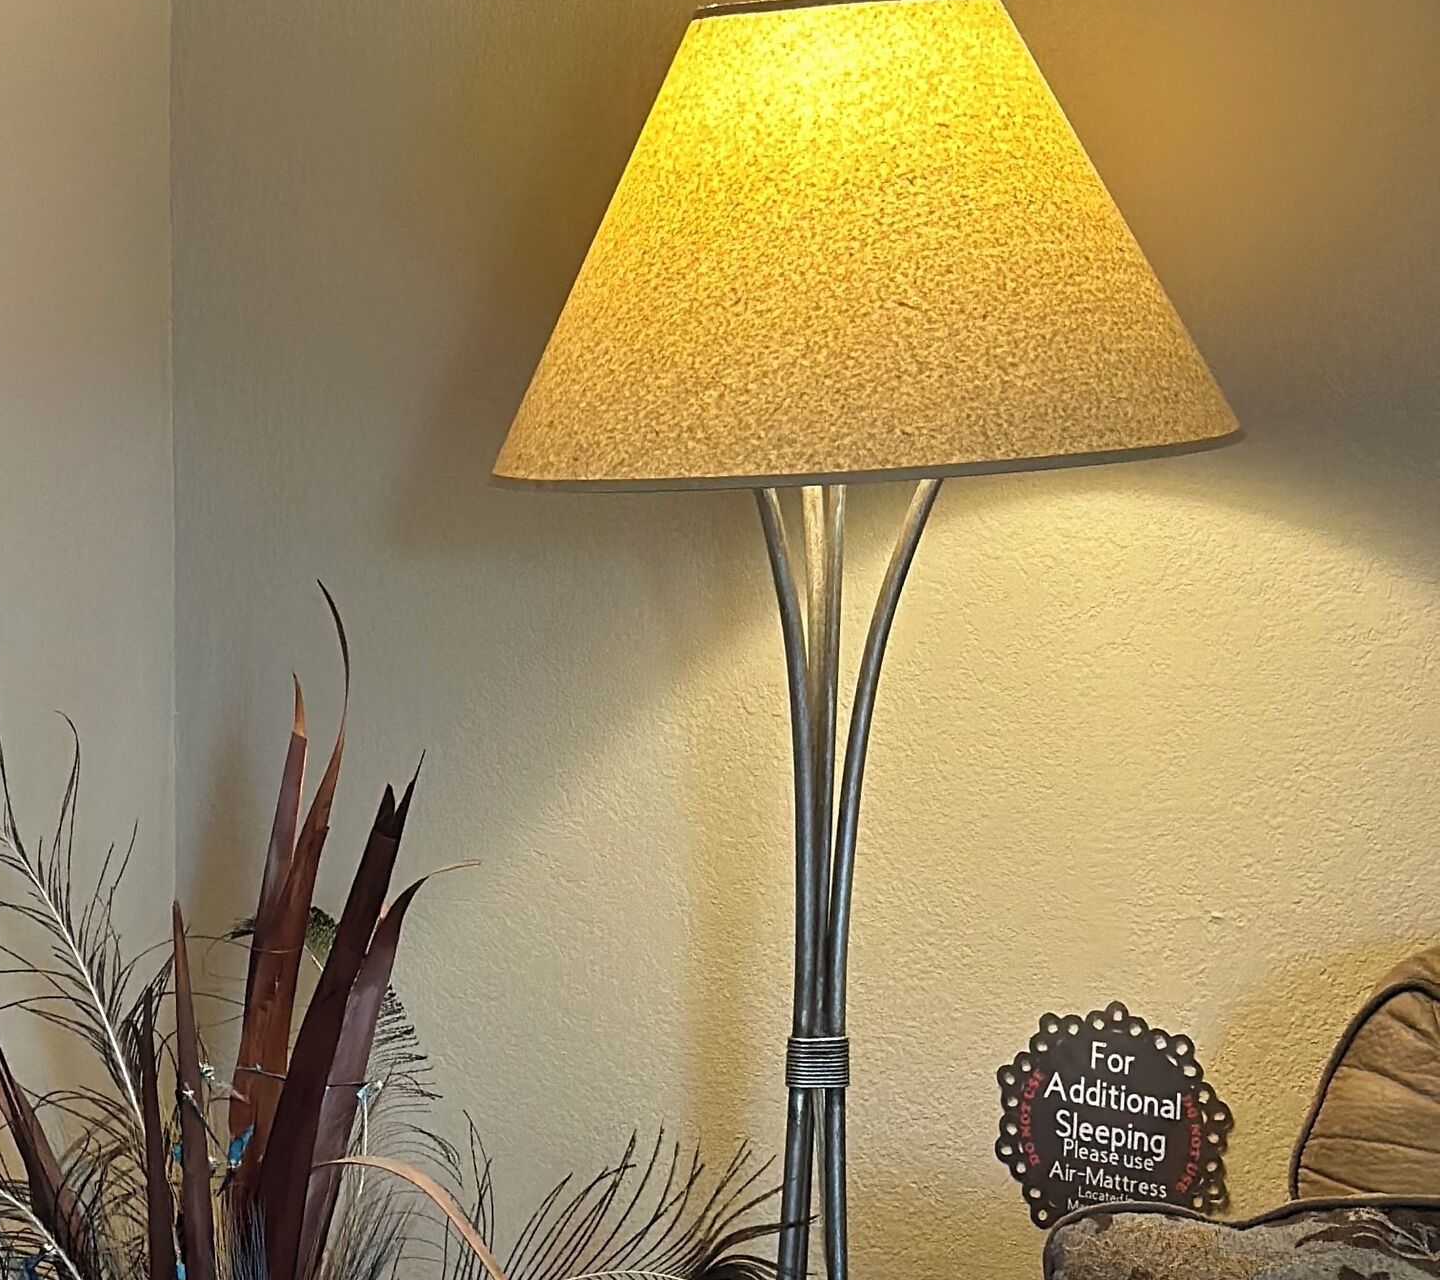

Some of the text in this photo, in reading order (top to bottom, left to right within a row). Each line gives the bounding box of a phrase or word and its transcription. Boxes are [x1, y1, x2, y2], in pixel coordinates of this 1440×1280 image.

[1090, 1041, 1135, 1075] For
[1023, 1067, 1044, 1099] USE
[1043, 1072, 1182, 1121] Additional
[1055, 1109, 1166, 1161] Sleeping
[1176, 1094, 1202, 1196] DO NOT USE
[1024, 1141, 1041, 1166] DO
[1063, 1138, 1154, 1172] Please use
[1049, 1160, 1167, 1198] Air-Mattress
